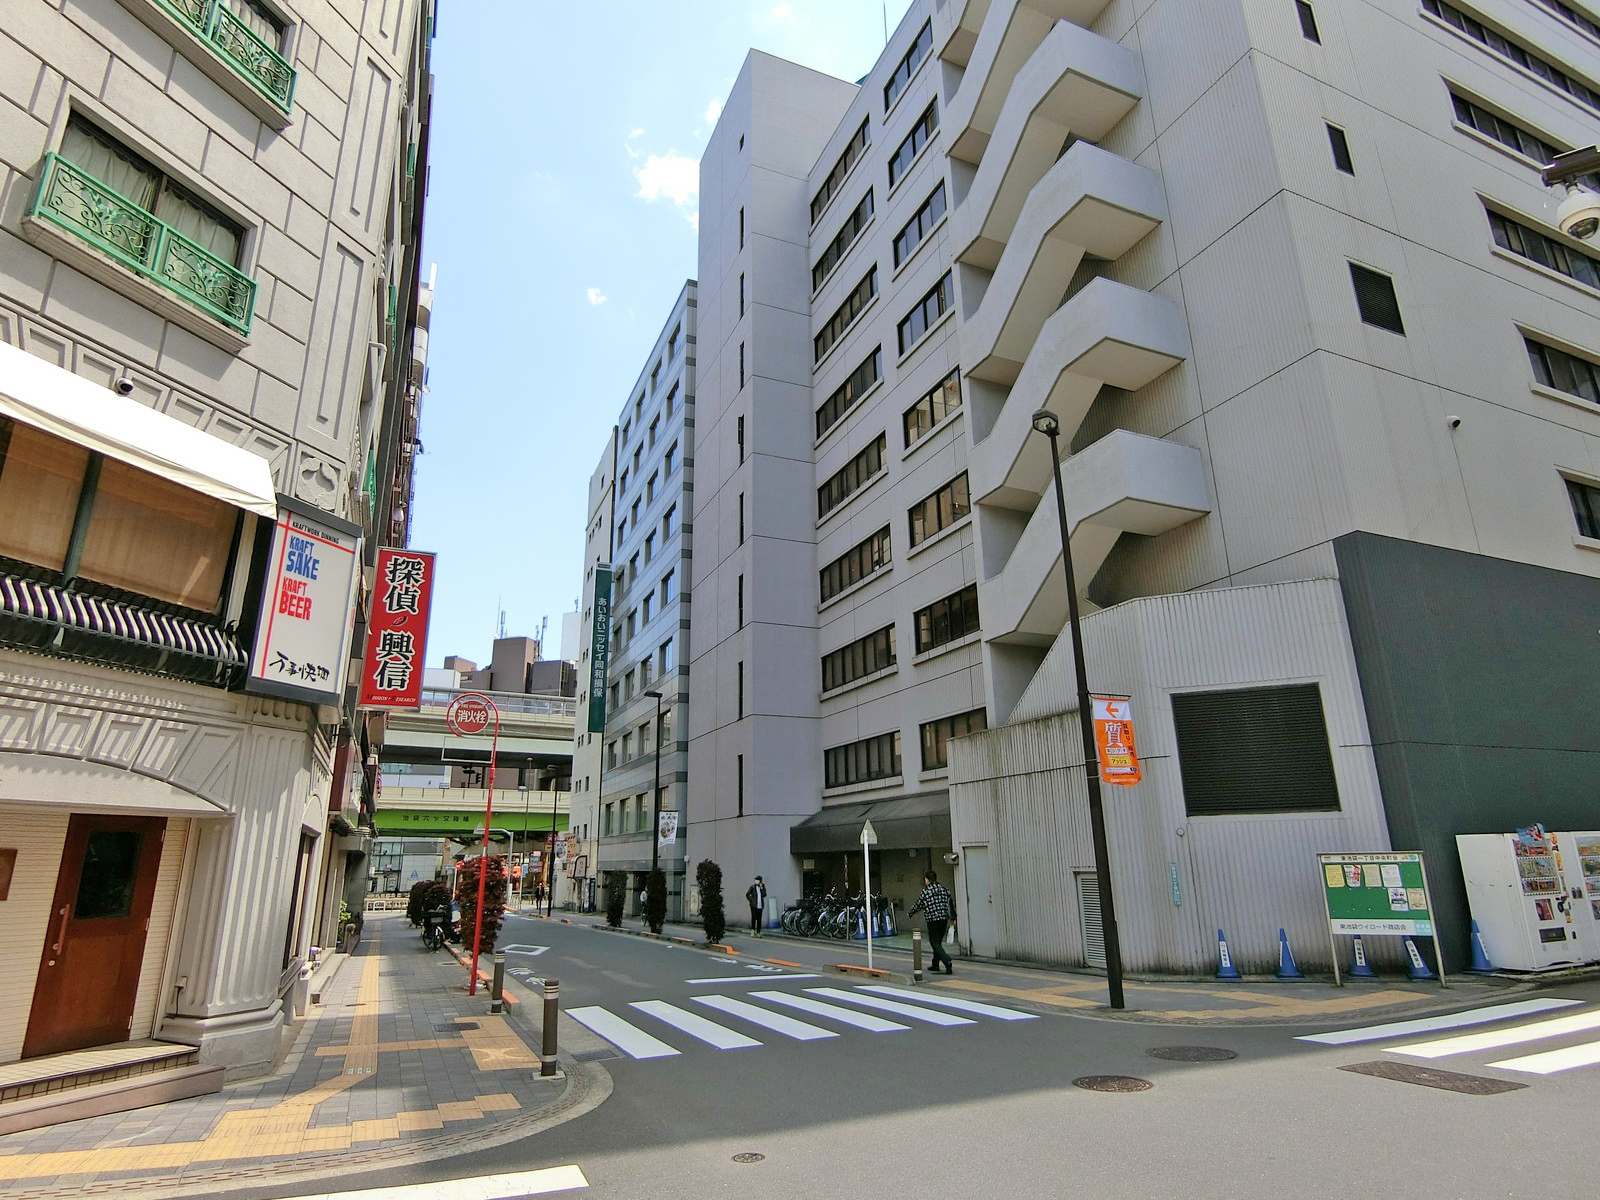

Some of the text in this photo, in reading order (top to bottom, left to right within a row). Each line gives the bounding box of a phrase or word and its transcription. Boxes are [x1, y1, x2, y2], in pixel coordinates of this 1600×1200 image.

[289, 535, 315, 555] KRAFT
[292, 521, 340, 544] KRAFTWORK DINNING
[286, 550, 319, 580] SAKE
[282, 576, 308, 596] KRAFT
[384, 555, 425, 615] 探偵
[278, 595, 312, 620] BEER
[373, 629, 415, 691] 興信
[593, 597, 607, 698] あいおいニッセイ同和損保
[457, 710, 487, 724] 消火栓
[1104, 722, 1124, 748] 質
